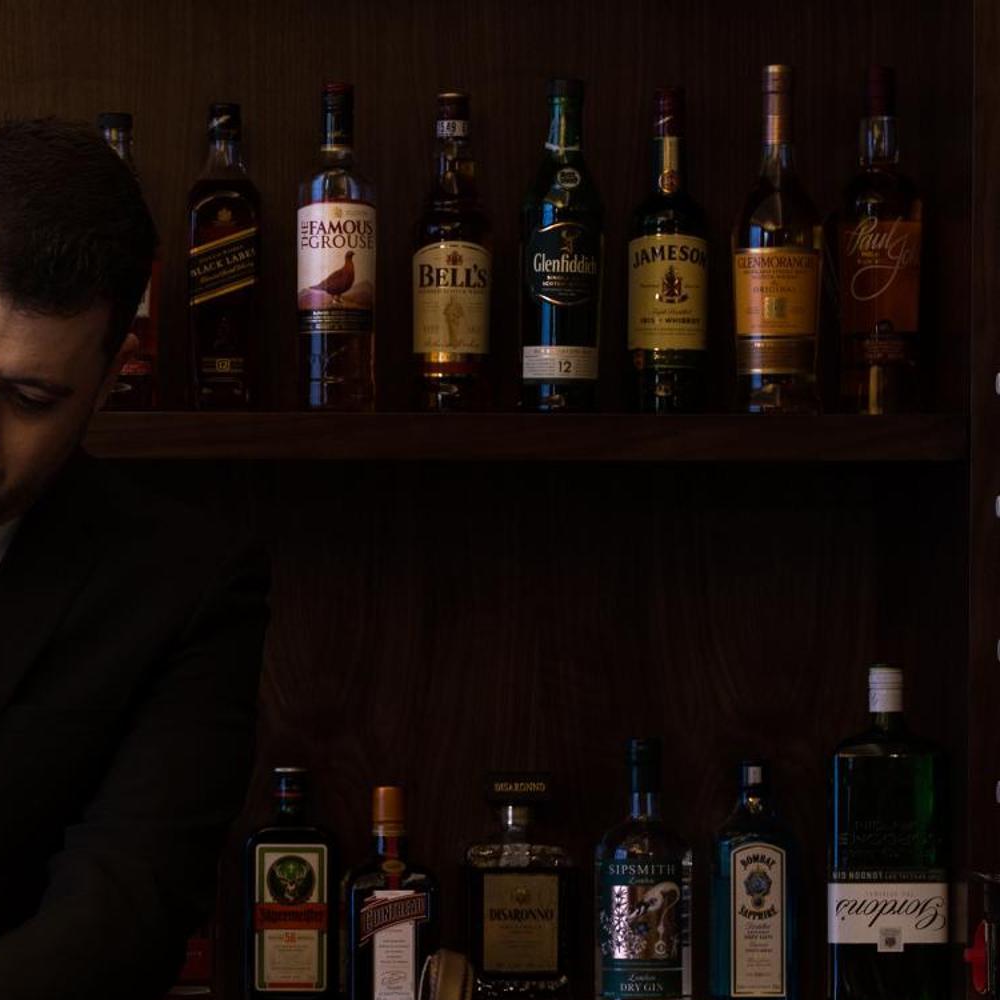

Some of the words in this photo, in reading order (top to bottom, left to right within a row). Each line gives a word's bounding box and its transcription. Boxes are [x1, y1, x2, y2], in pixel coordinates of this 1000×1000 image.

[309, 220, 374, 235] FAMOUS
[309, 235, 374, 249] GROUSE
[533, 252, 598, 274] Glenfiddich
[633, 245, 707, 269] JAMESON
[419, 264, 487, 288] BELL'S
[558, 360, 572, 373] 12
[608, 864, 675, 875] SIPSMITH
[490, 907, 554, 921] DISARONNO
